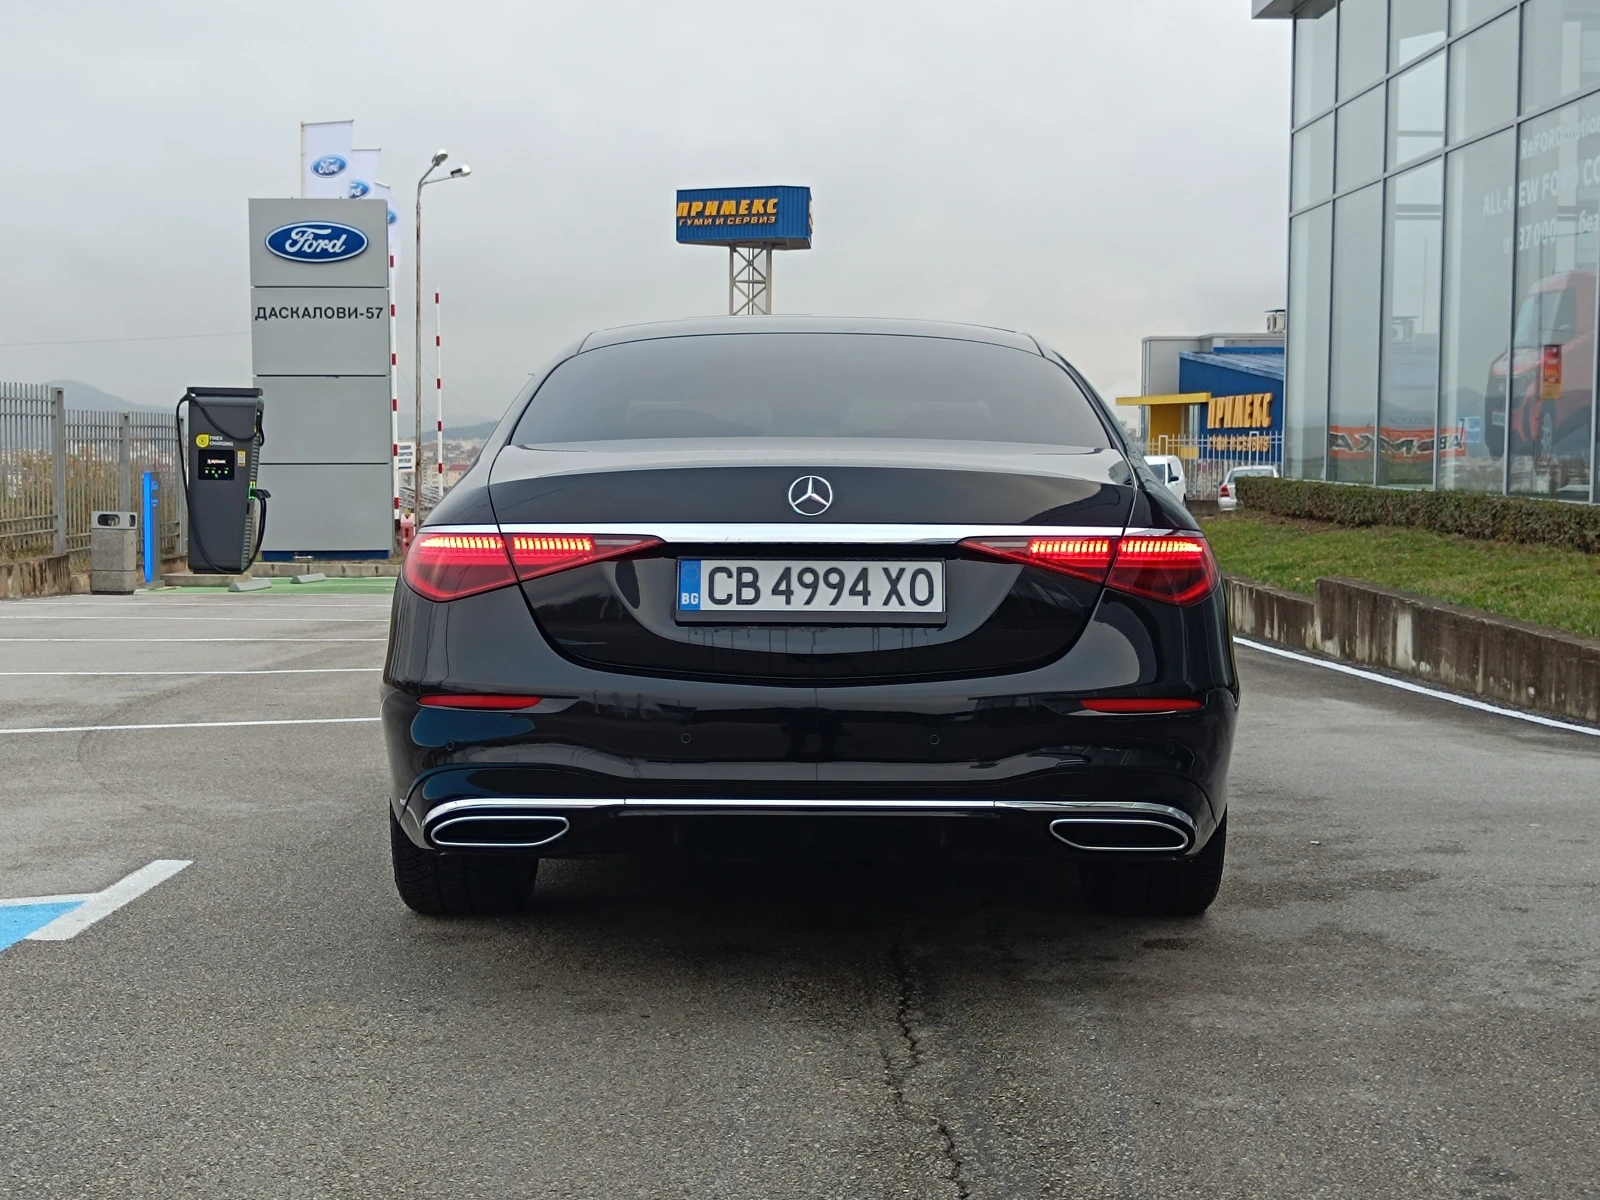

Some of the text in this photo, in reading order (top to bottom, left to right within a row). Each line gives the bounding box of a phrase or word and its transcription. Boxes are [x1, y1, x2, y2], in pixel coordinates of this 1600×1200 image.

[677, 198, 779, 217] ПРИМЕКС
[679, 216, 776, 227] ГУМИ И СЕРВИЗ
[285, 227, 347, 253] Ford
[255, 306, 384, 321] ДАСКАЛОВИ-57
[1207, 392, 1273, 430] ПРИМЕКС
[708, 566, 935, 606] CB 4994 XO
[681, 593, 699, 605] BG
